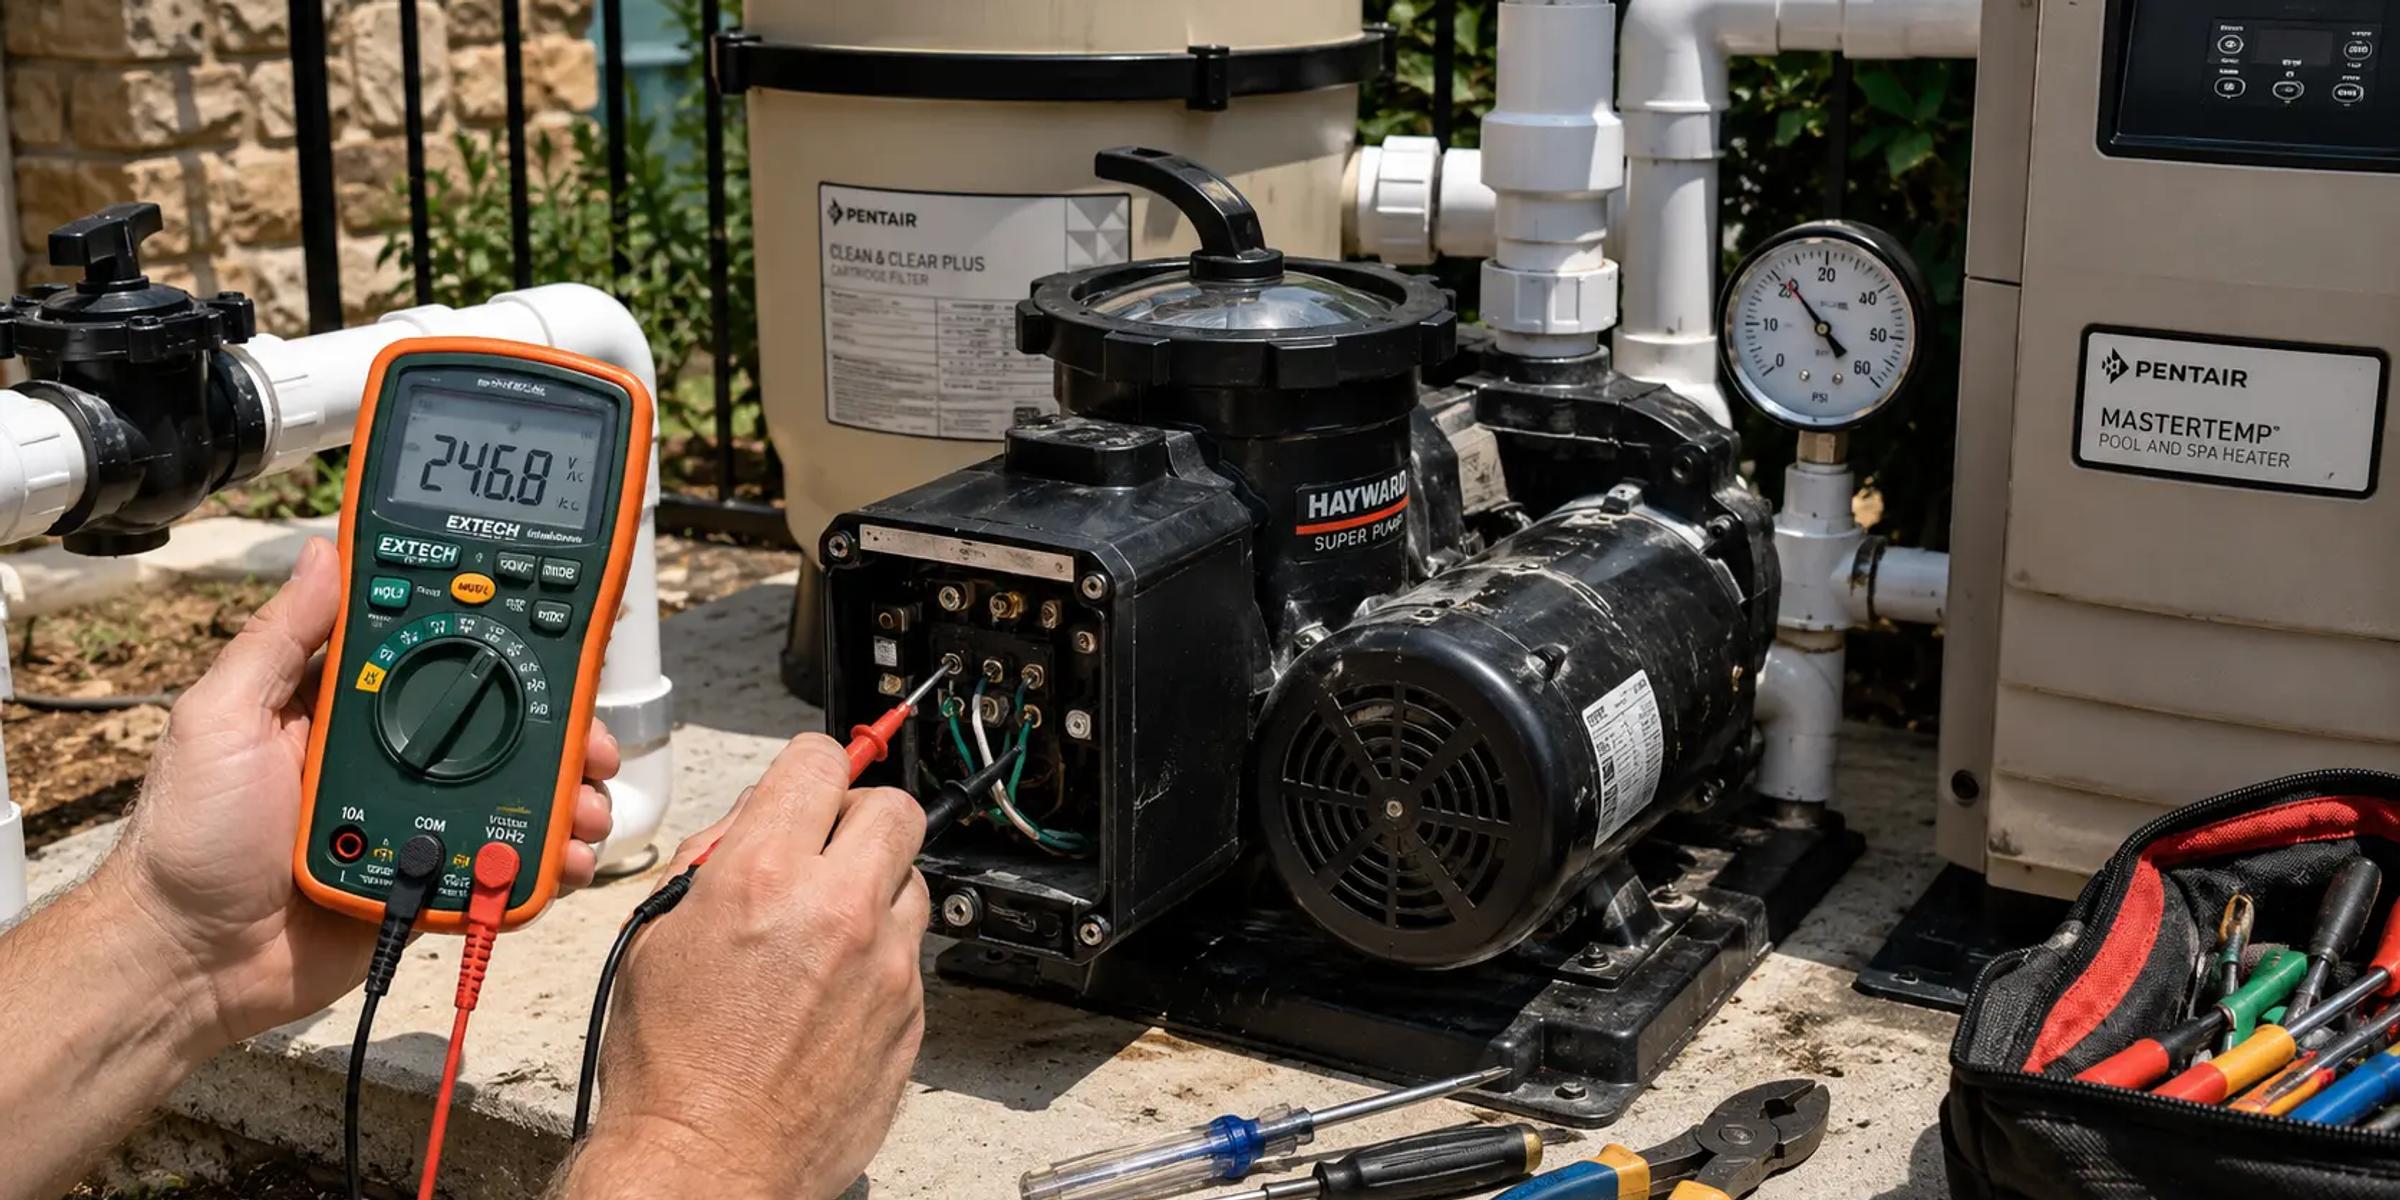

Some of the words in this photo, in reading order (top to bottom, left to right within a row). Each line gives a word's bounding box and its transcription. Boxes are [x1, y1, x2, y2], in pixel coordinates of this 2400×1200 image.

[846, 207, 917, 228] PENTAIR
[829, 243, 872, 264] CLEAN
[875, 250, 885, 265] &
[888, 251, 938, 269] CLEAR
[942, 255, 985, 272] PLUS
[889, 273, 929, 286] FILTER
[1818, 267, 1836, 282] 20
[1859, 291, 1877, 306] 40
[1763, 318, 1778, 331] 10
[1869, 328, 1887, 343] 50
[1775, 353, 1785, 367] 0
[1854, 360, 1871, 375] 60
[2135, 360, 2248, 388] PENTAIR
[1812, 391, 1828, 403] PSI
[2099, 433, 2141, 451] POOL
[2147, 440, 2182, 456] AND
[2187, 443, 2218, 460] SPA
[2222, 447, 2290, 468] HEATER
[1308, 469, 1407, 519] HAYWARD
[446, 514, 520, 537] EXTECH
[1314, 527, 1367, 552] SUPER
[379, 536, 458, 562] EXTECH
[341, 806, 365, 822] 10A
[414, 816, 447, 832] COM
